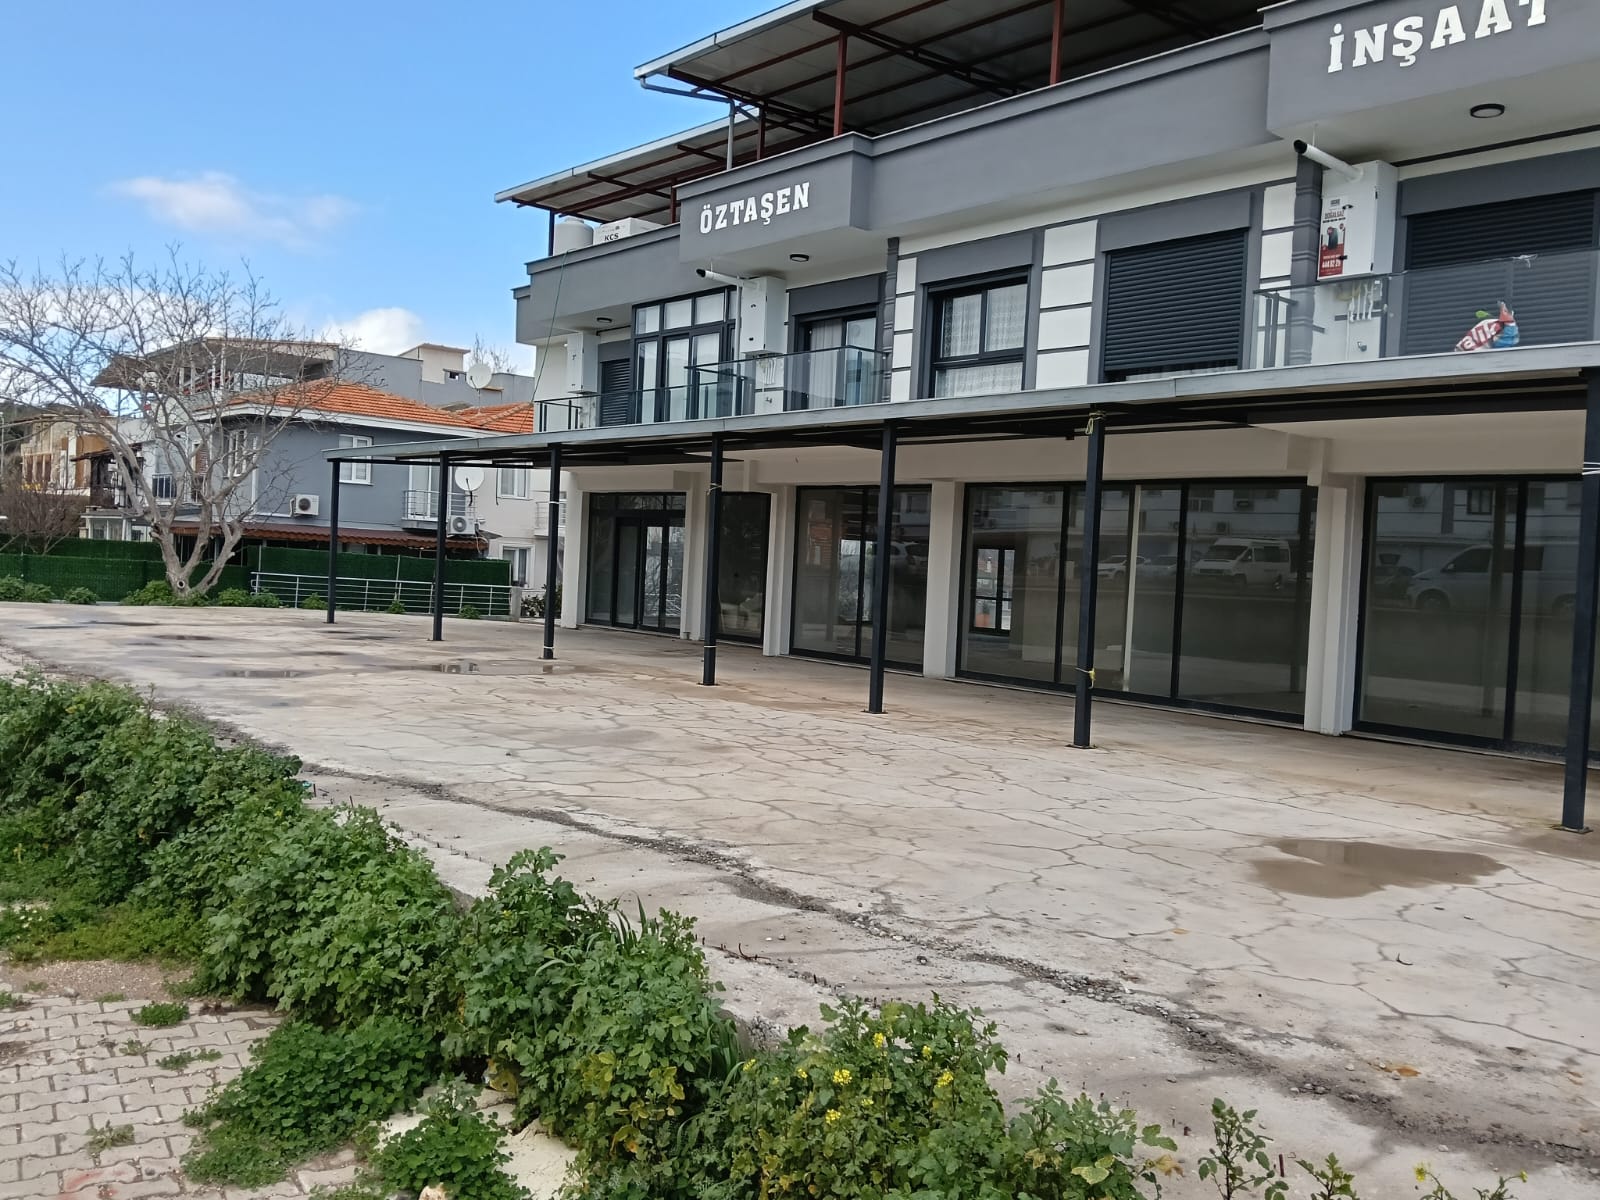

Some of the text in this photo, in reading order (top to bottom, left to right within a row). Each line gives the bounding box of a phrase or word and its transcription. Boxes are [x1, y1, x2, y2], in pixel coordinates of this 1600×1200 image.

[1328, 0, 1547, 73] İNŞAAT
[699, 181, 810, 234] ÖZTAŞEN
[604, 232, 619, 241] KCS
